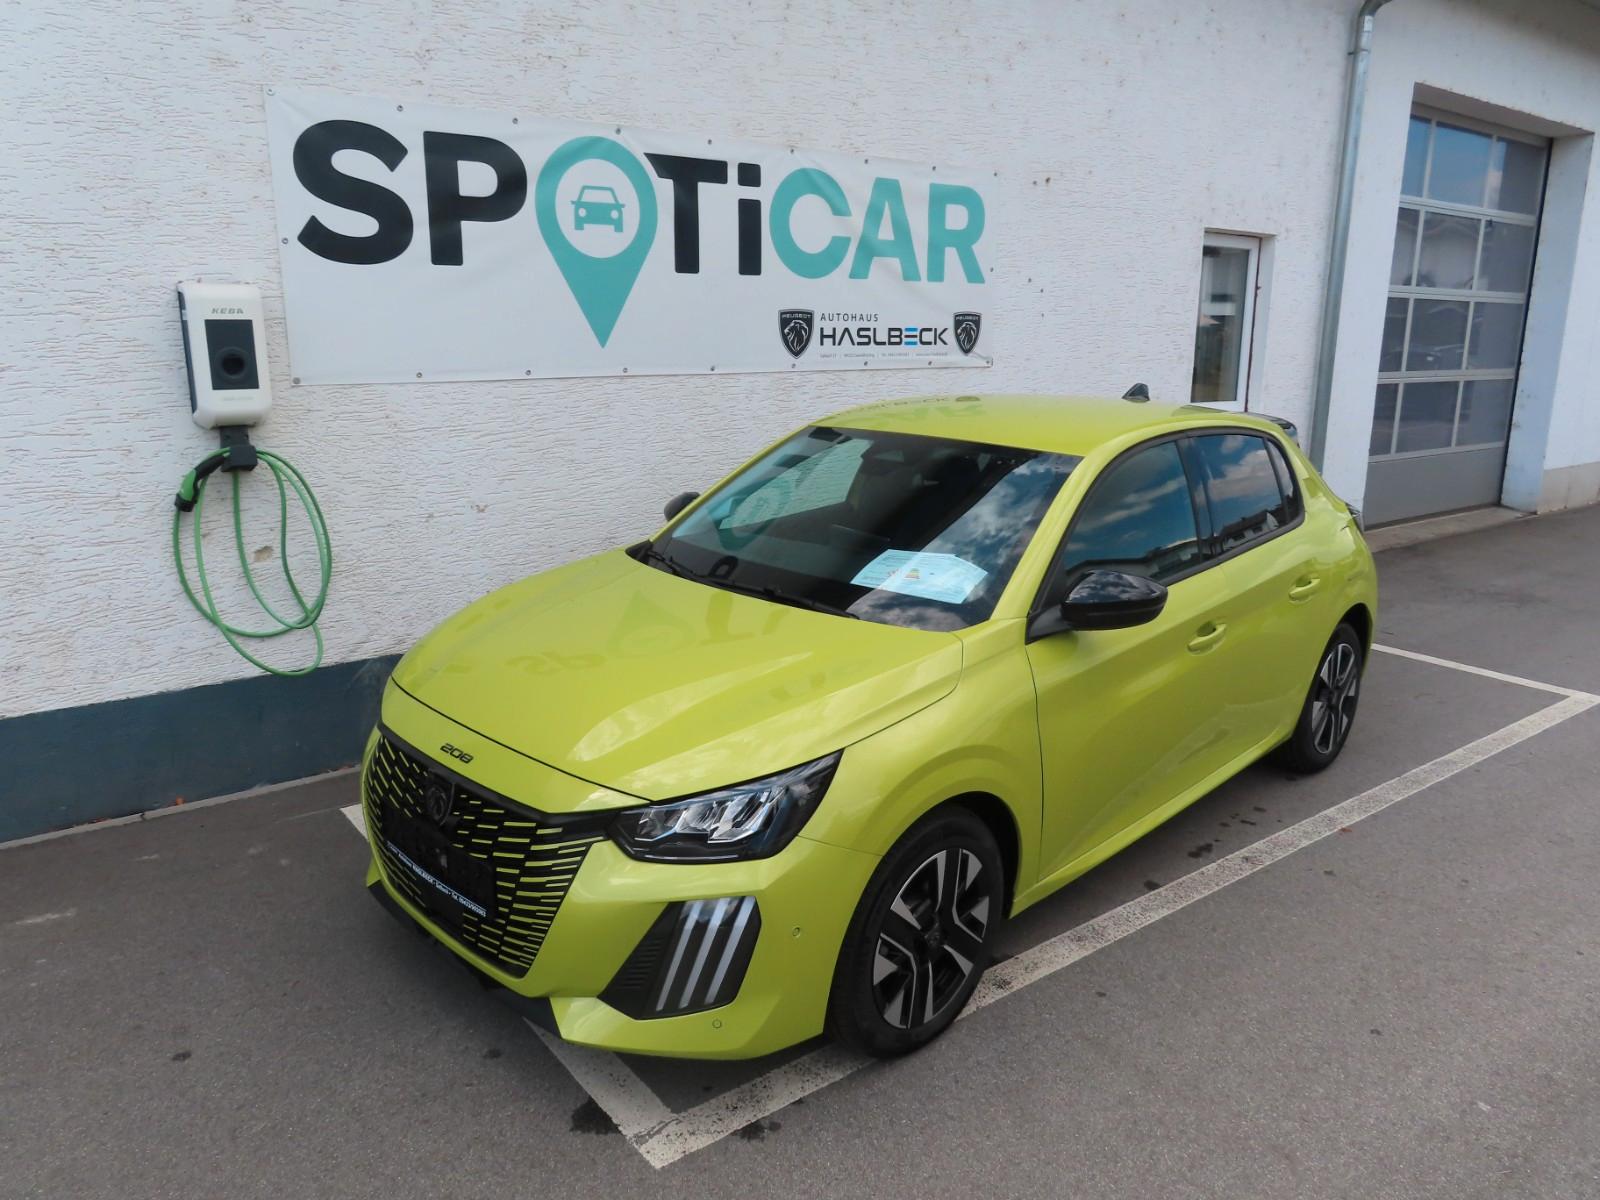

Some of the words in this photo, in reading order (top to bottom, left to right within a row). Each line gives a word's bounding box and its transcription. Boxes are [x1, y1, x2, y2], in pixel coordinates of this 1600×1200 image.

[211, 307, 244, 315] KEBA
[820, 312, 879, 322] AUTOHAUS
[819, 326, 949, 346] HASLBECK
[440, 743, 474, 764] 208
